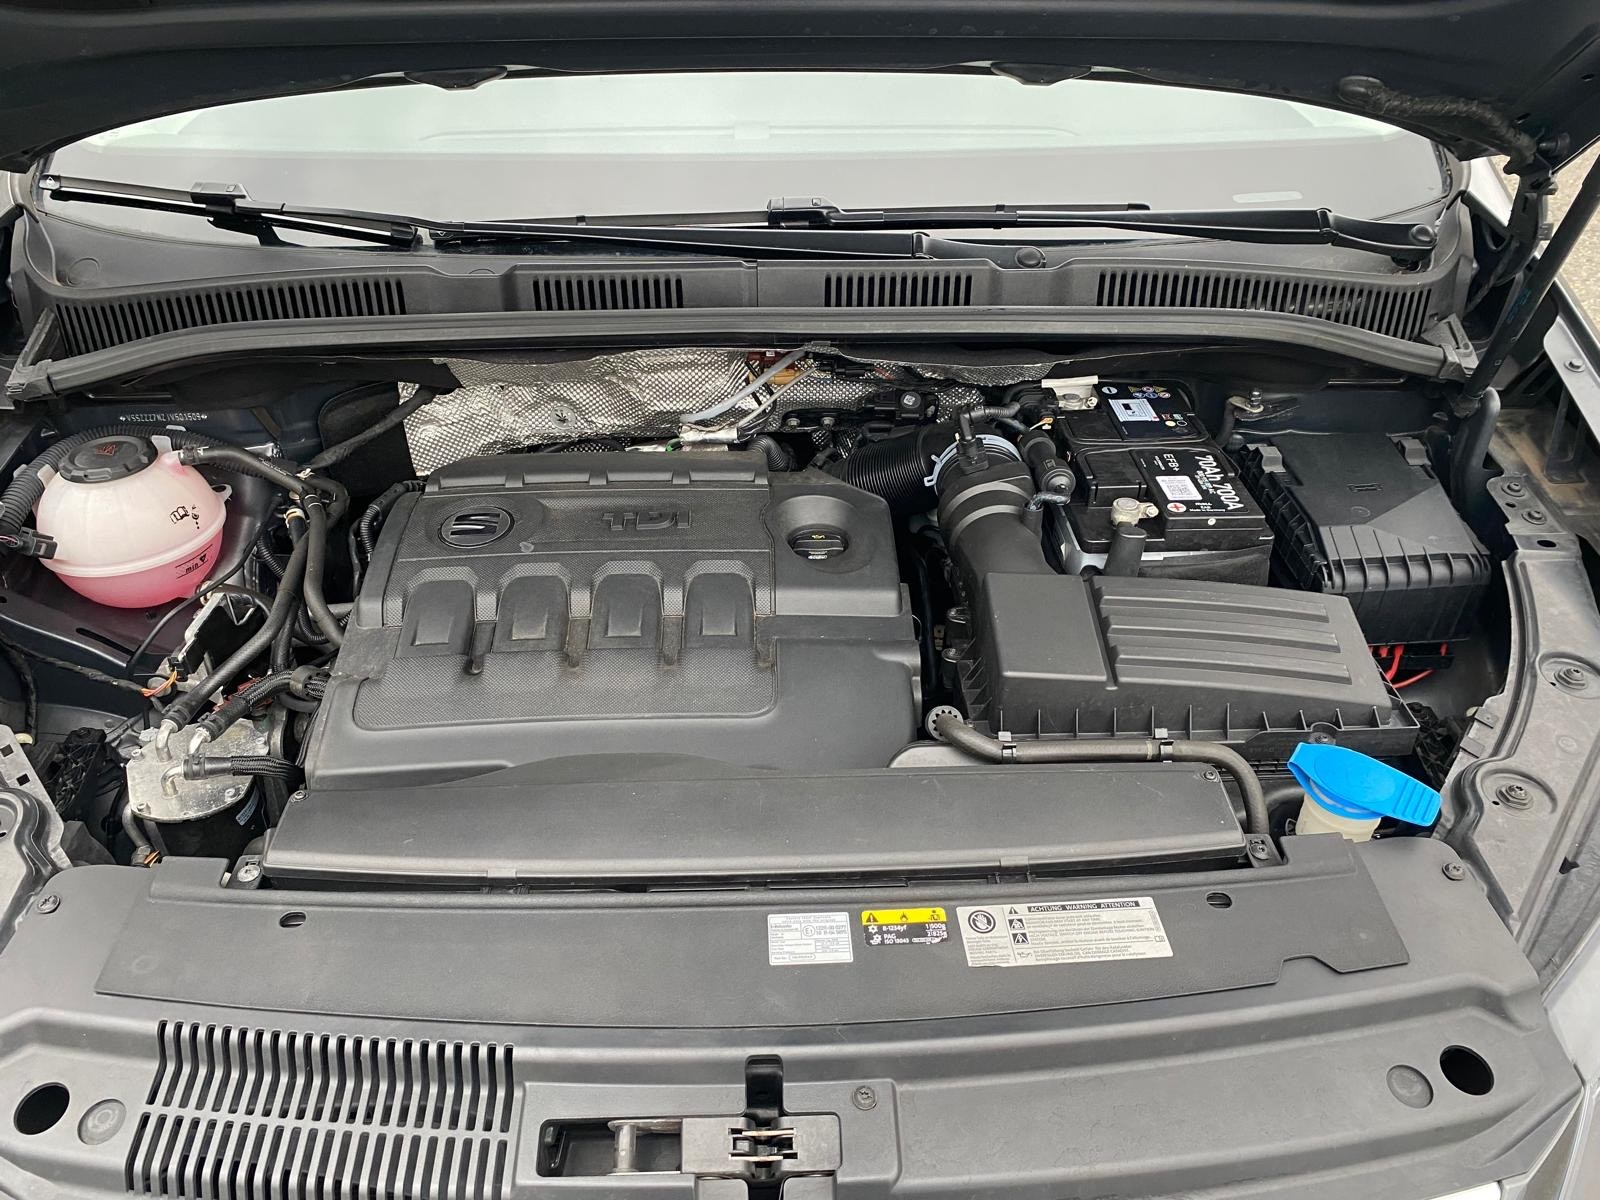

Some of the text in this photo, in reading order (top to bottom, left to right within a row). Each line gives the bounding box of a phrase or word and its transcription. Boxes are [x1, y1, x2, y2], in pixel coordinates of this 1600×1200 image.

[1163, 453, 1180, 472] EFB+
[1195, 455, 1223, 482] 70Ah
[1216, 483, 1244, 511] 700A
[602, 510, 692, 531] TDI
[186, 562, 199, 573] min
[1065, 903, 1098, 911] WARNING
[1100, 901, 1136, 909] ATTENTION
